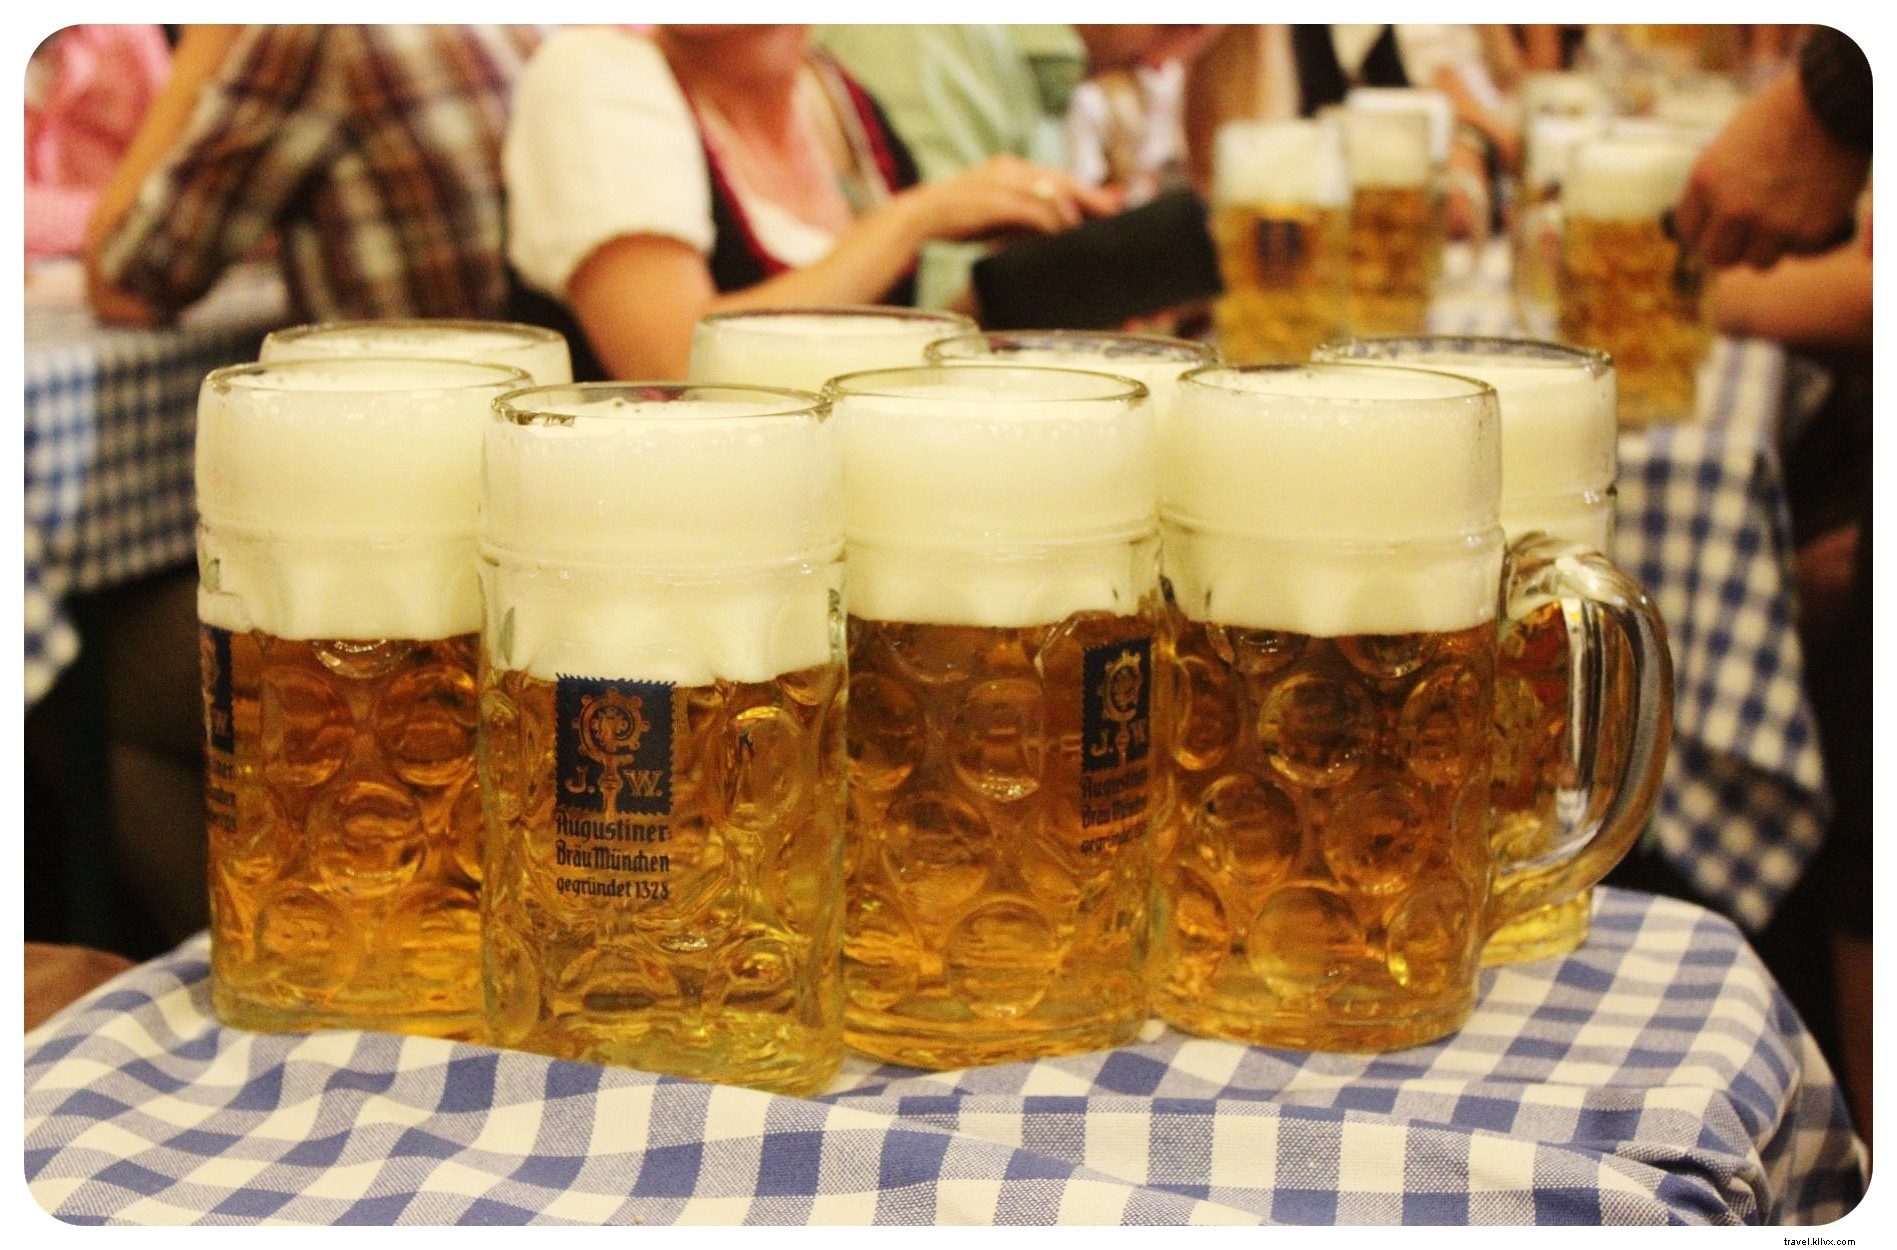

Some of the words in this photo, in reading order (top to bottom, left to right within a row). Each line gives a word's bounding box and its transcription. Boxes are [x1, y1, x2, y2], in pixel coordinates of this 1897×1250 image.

[556, 839, 592, 868] Bräu
[593, 846, 670, 873] München
[556, 876, 632, 899] gegründet
[635, 880, 671, 900] 1328
